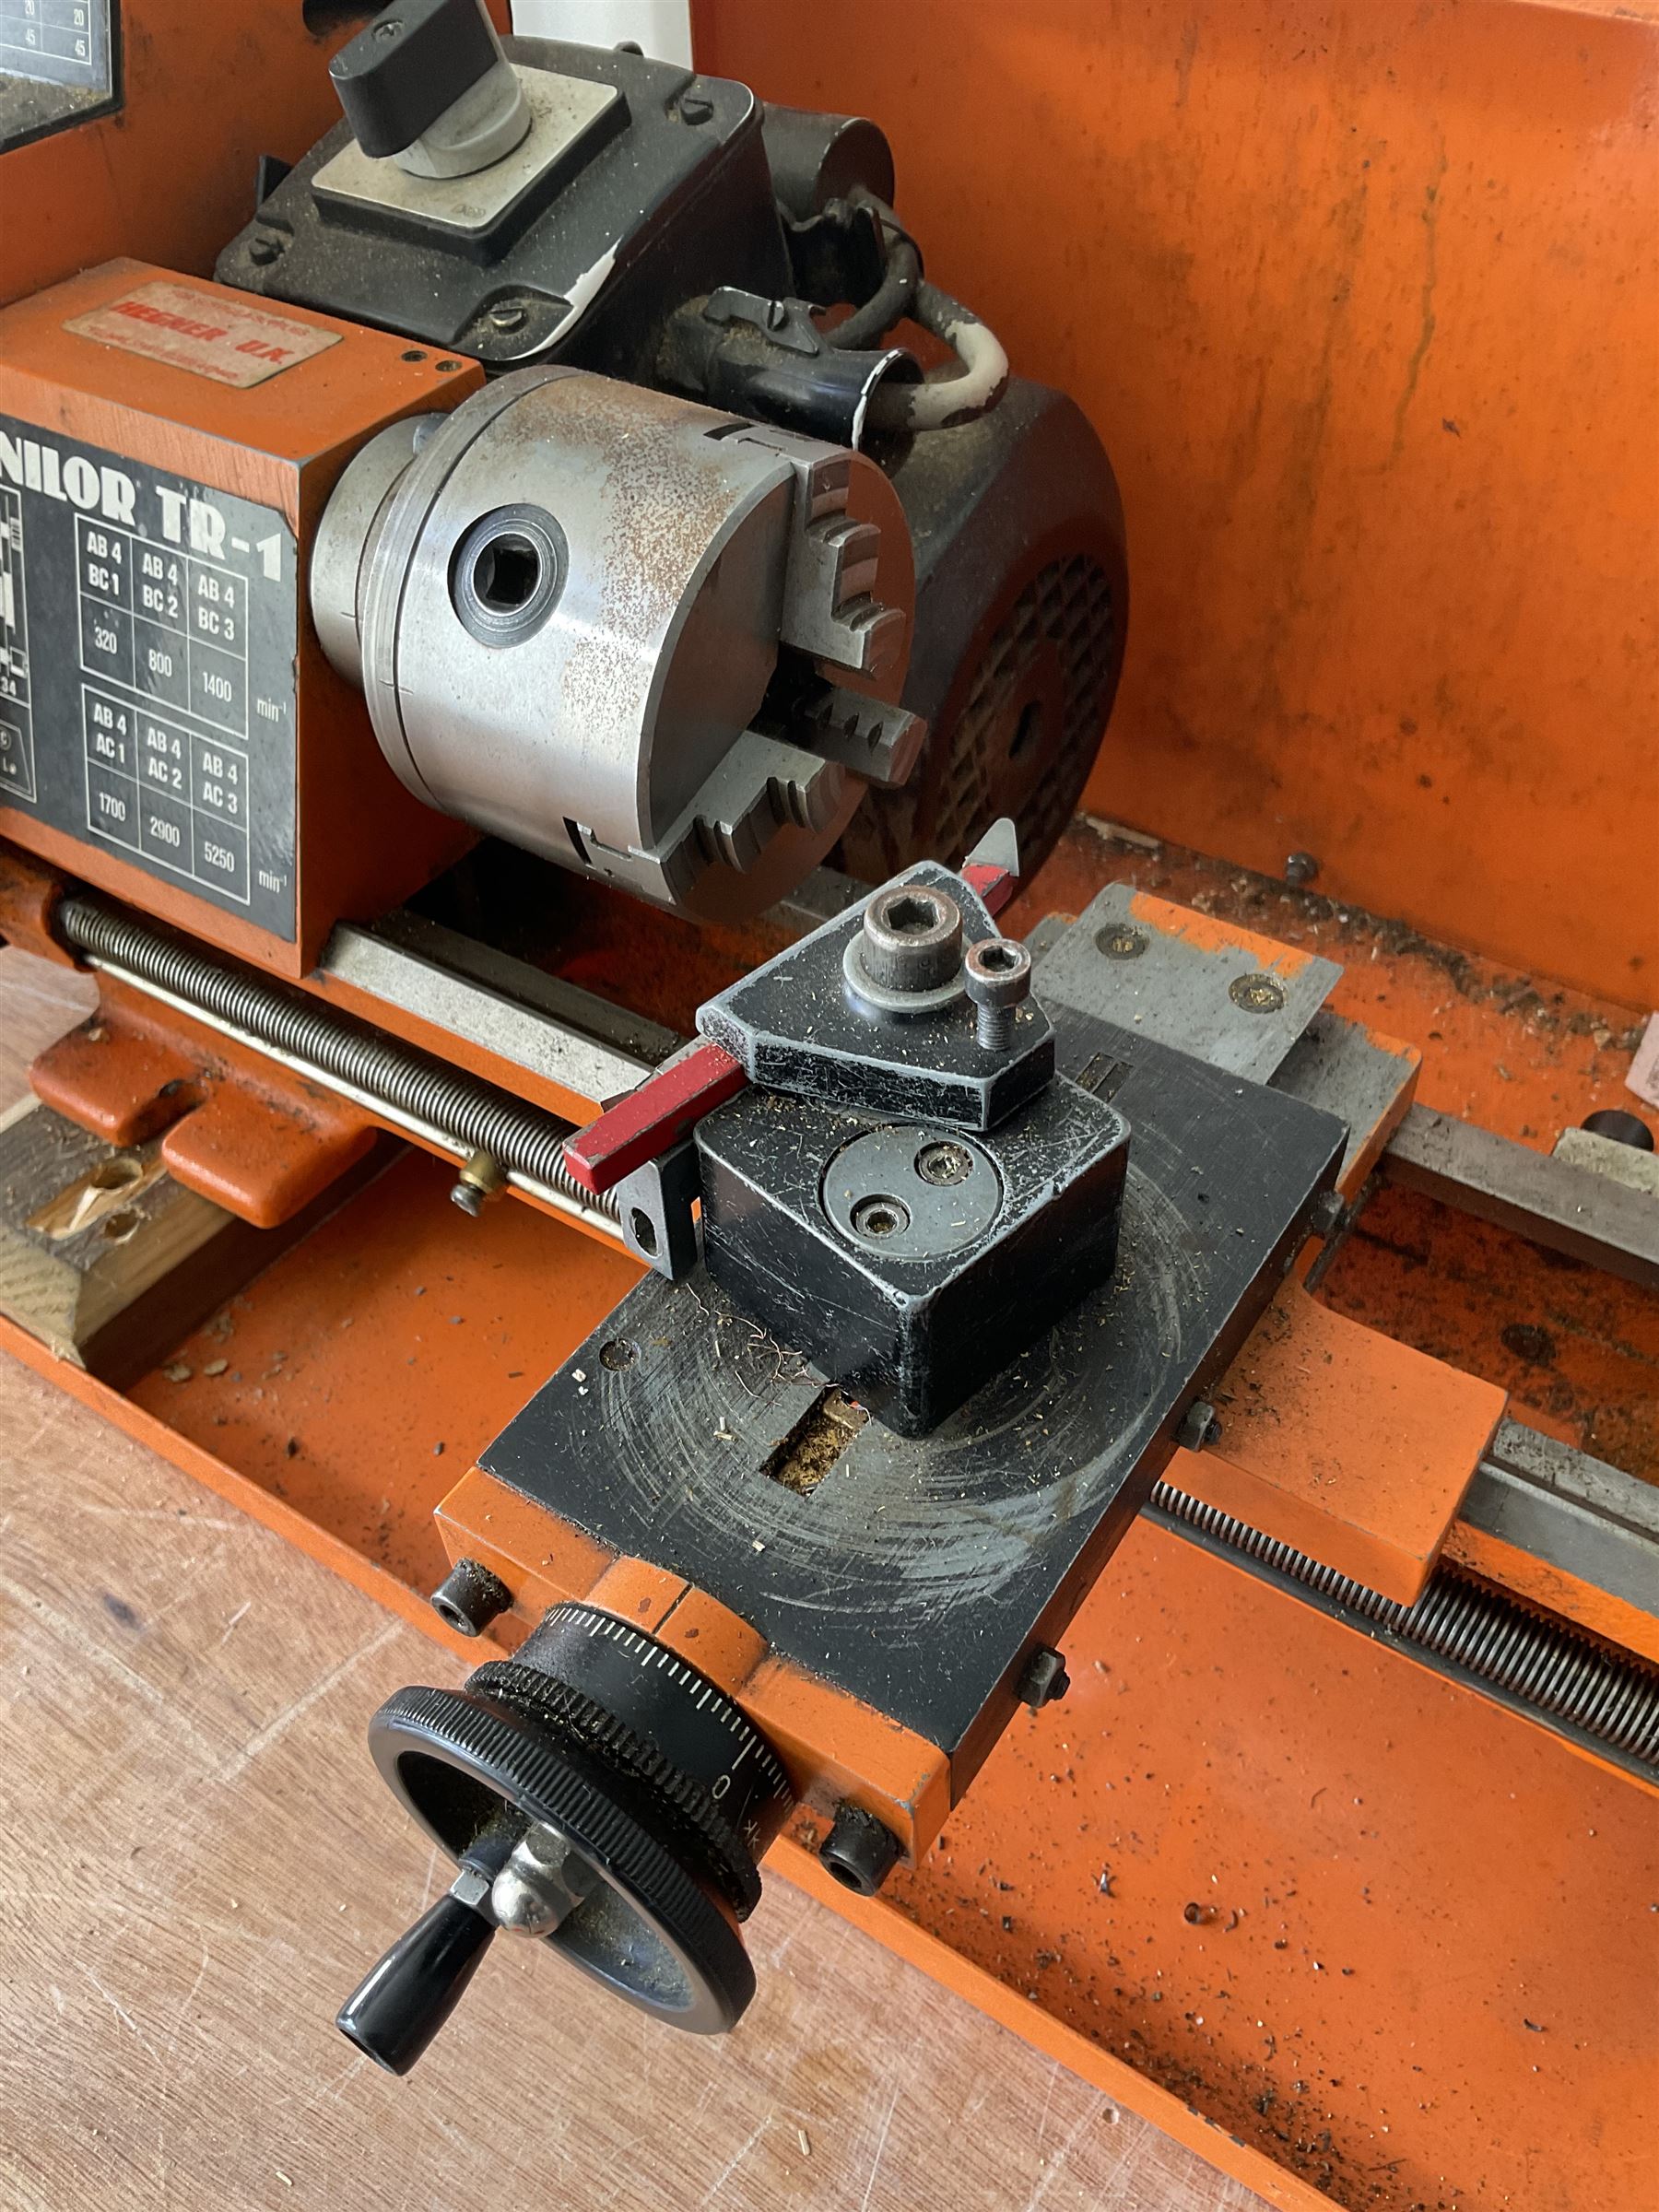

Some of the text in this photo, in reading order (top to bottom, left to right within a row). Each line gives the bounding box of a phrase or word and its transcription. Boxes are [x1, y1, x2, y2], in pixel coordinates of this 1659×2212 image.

[74, 8, 84, 26] 20
[25, 29, 36, 46] 45
[75, 40, 86, 56] 45
[86, 530, 123, 565] AB 4
[156, 485, 281, 582] TR-1
[88, 562, 120, 596] BC 1
[141, 552, 179, 586] AB 4
[142, 583, 179, 619] BC 2
[197, 574, 235, 609] AB 4
[94, 626, 118, 655] 320
[197, 606, 235, 641] BC 3
[148, 648, 172, 677] 800
[202, 671, 232, 702] 1400
[92, 701, 127, 735] AB 4
[95, 732, 125, 764] AC 1
[146, 726, 182, 760] AB 4
[147, 756, 182, 790] AC 2
[202, 751, 239, 785] AB 4
[98, 791, 126, 822] 1700
[202, 781, 238, 815] AC 3
[149, 816, 181, 848] 2900
[204, 841, 235, 873] 5250
